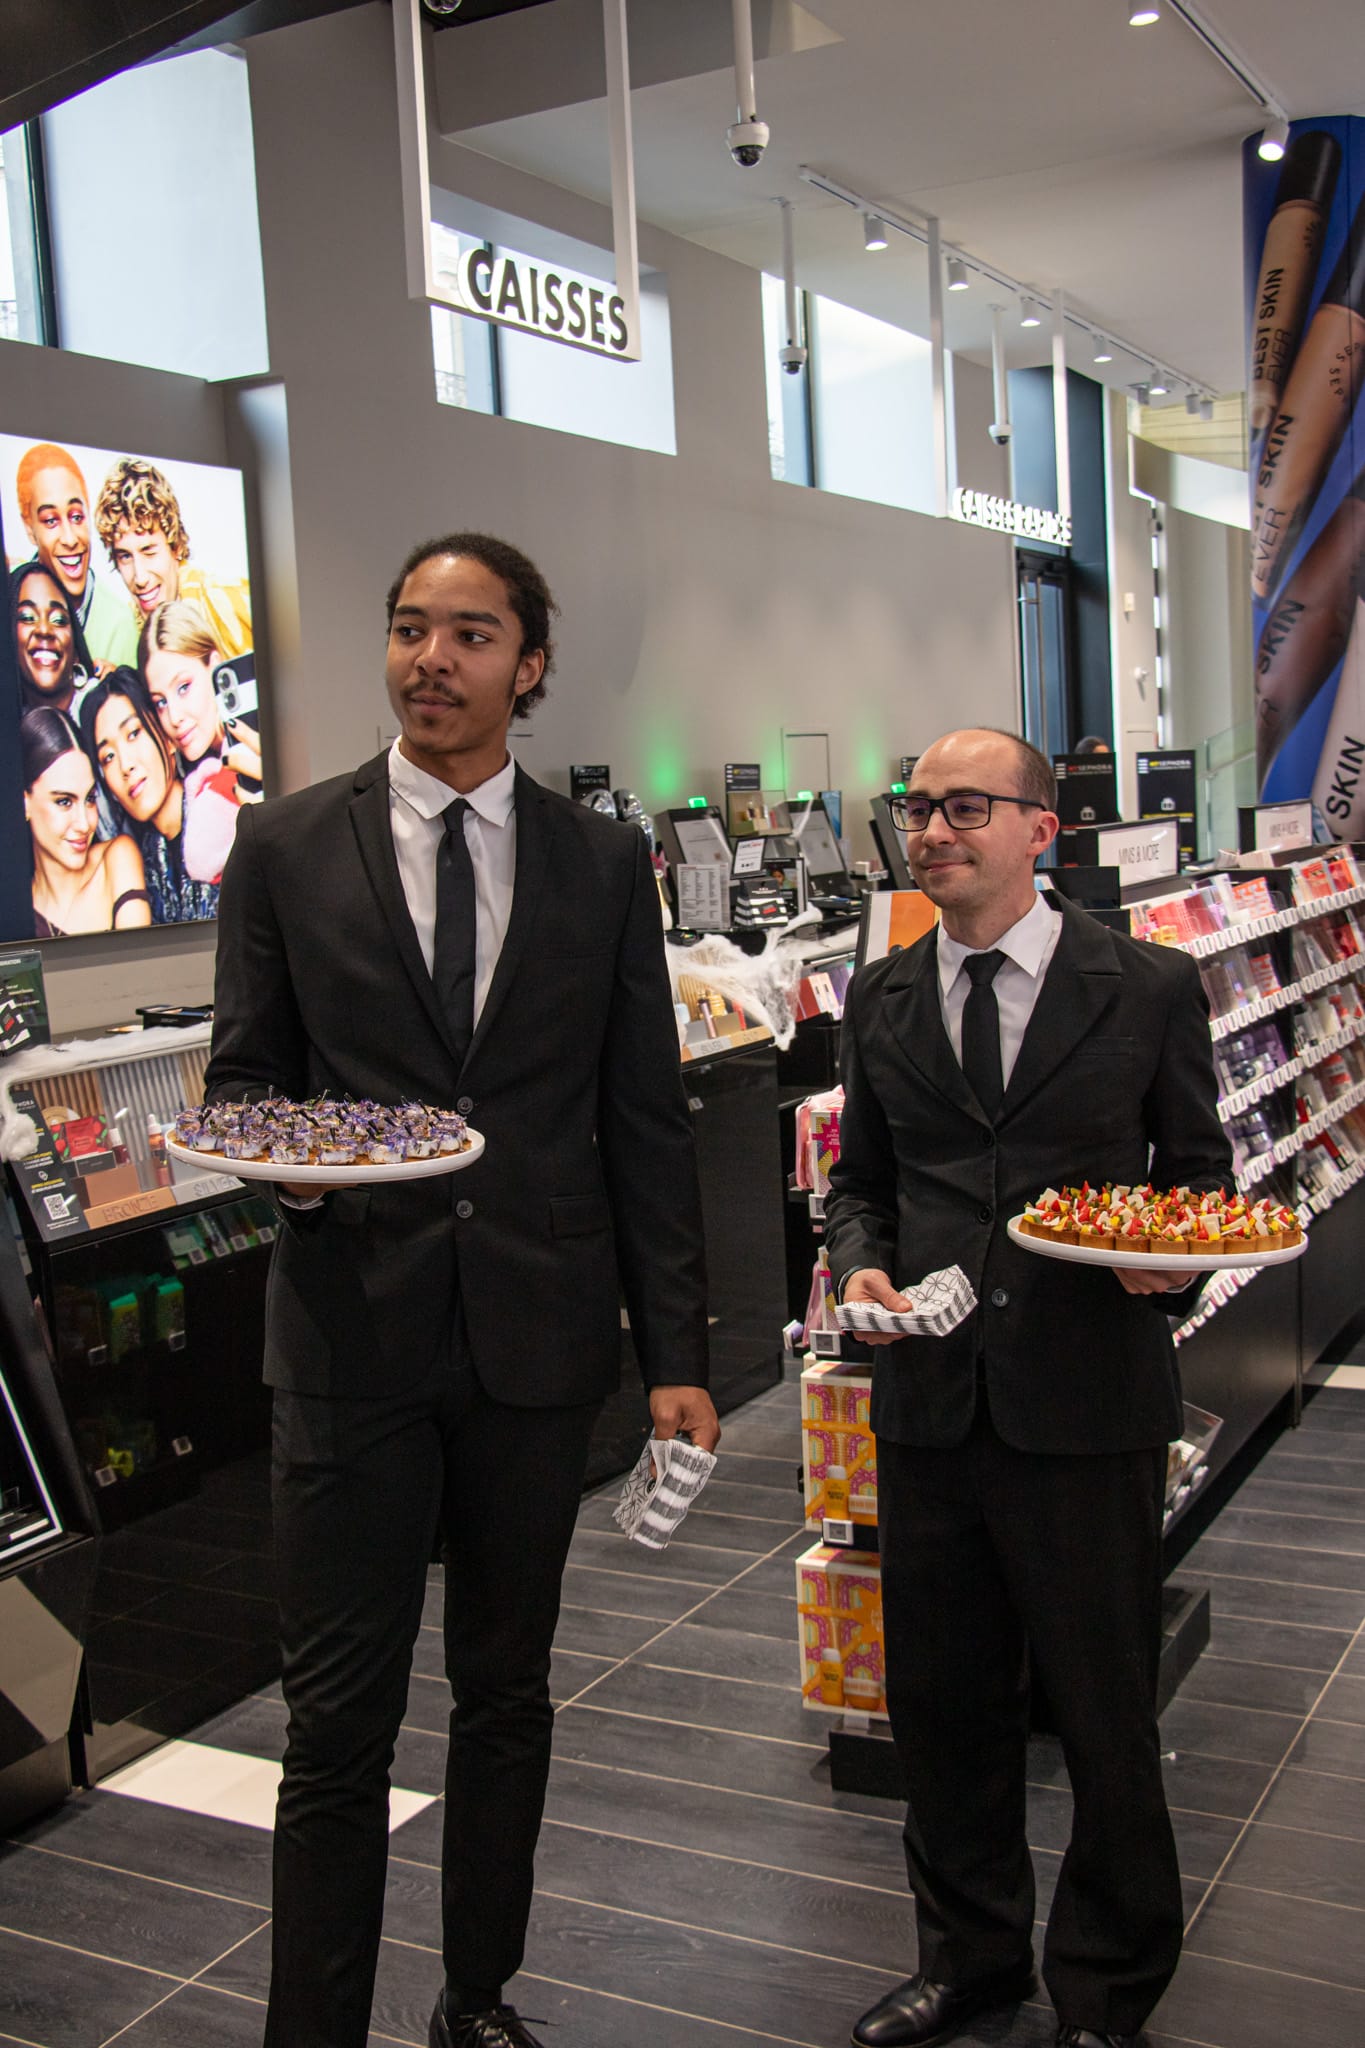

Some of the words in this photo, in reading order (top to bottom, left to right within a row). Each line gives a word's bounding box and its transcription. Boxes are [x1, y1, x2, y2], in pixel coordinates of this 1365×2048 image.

[460, 248, 628, 351] CAISSES
[1259, 268, 1285, 320] SKIN
[1267, 328, 1292, 384] EVER
[1259, 414, 1295, 488] SKIN
[1256, 507, 1286, 582] EVER
[1259, 600, 1304, 675] SKIN
[1326, 736, 1365, 820] SKIN
